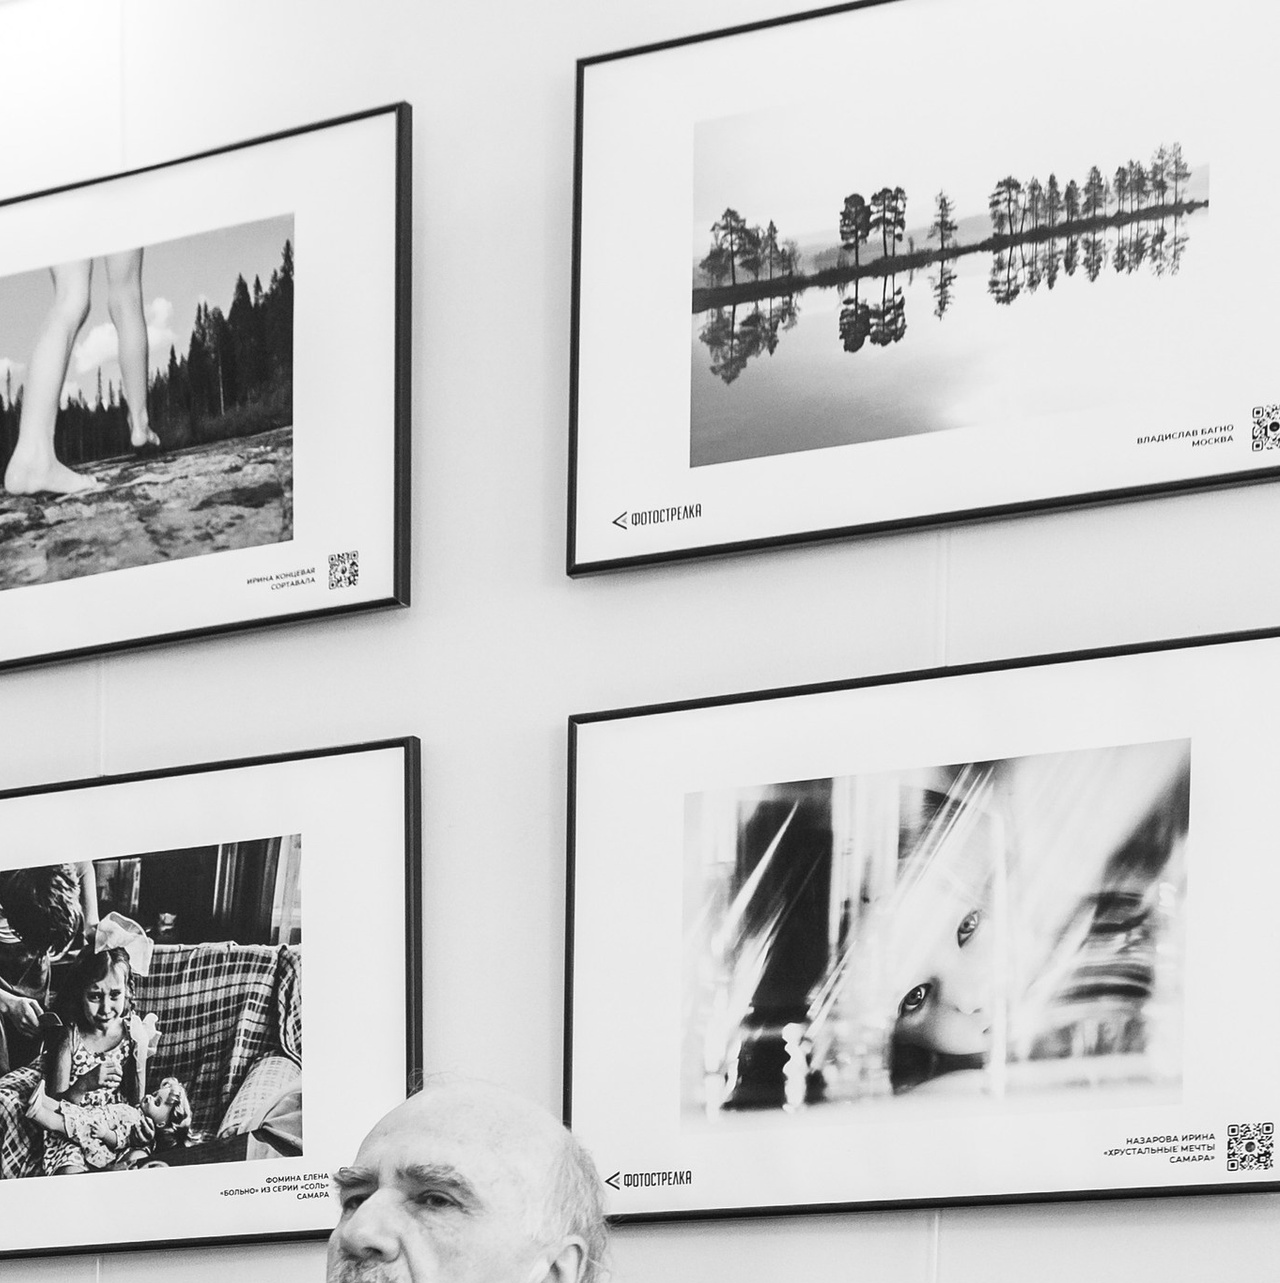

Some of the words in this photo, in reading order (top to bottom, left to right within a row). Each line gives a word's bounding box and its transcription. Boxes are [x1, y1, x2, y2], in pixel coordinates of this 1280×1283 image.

[1137, 429, 1198, 444] ВЛАДИСЛАВ
[1201, 424, 1234, 435] БАГНО
[1192, 435, 1234, 447] МОСКВА
[631, 503, 702, 527] ФОТОСТРЕЛКА
[247, 575, 274, 585] ИРИНА
[270, 577, 316, 590] СОРТАВАЛА
[1126, 1135, 1179, 1145] НАЗАРОВА
[1181, 1133, 1216, 1142] ИРИНА
[1103, 1145, 1178, 1156] «ХРУСТАЛЬНЫЕ
[1181, 1143, 1216, 1153] МЕЧТЫ
[1169, 1154, 1216, 1164] САМАРА»
[265, 1175, 300, 1184] ФОМИНА
[303, 1173, 330, 1181] ЕЛЕНА
[623, 1170, 692, 1188] ФОТОСТРЕЛКА
[220, 1187, 259, 1196] «БОЛЬНО»
[272, 1184, 299, 1193] СЕРИИ
[300, 1182, 330, 1191] «СОЛЬ»
[297, 1191, 330, 1200] САМАРА
